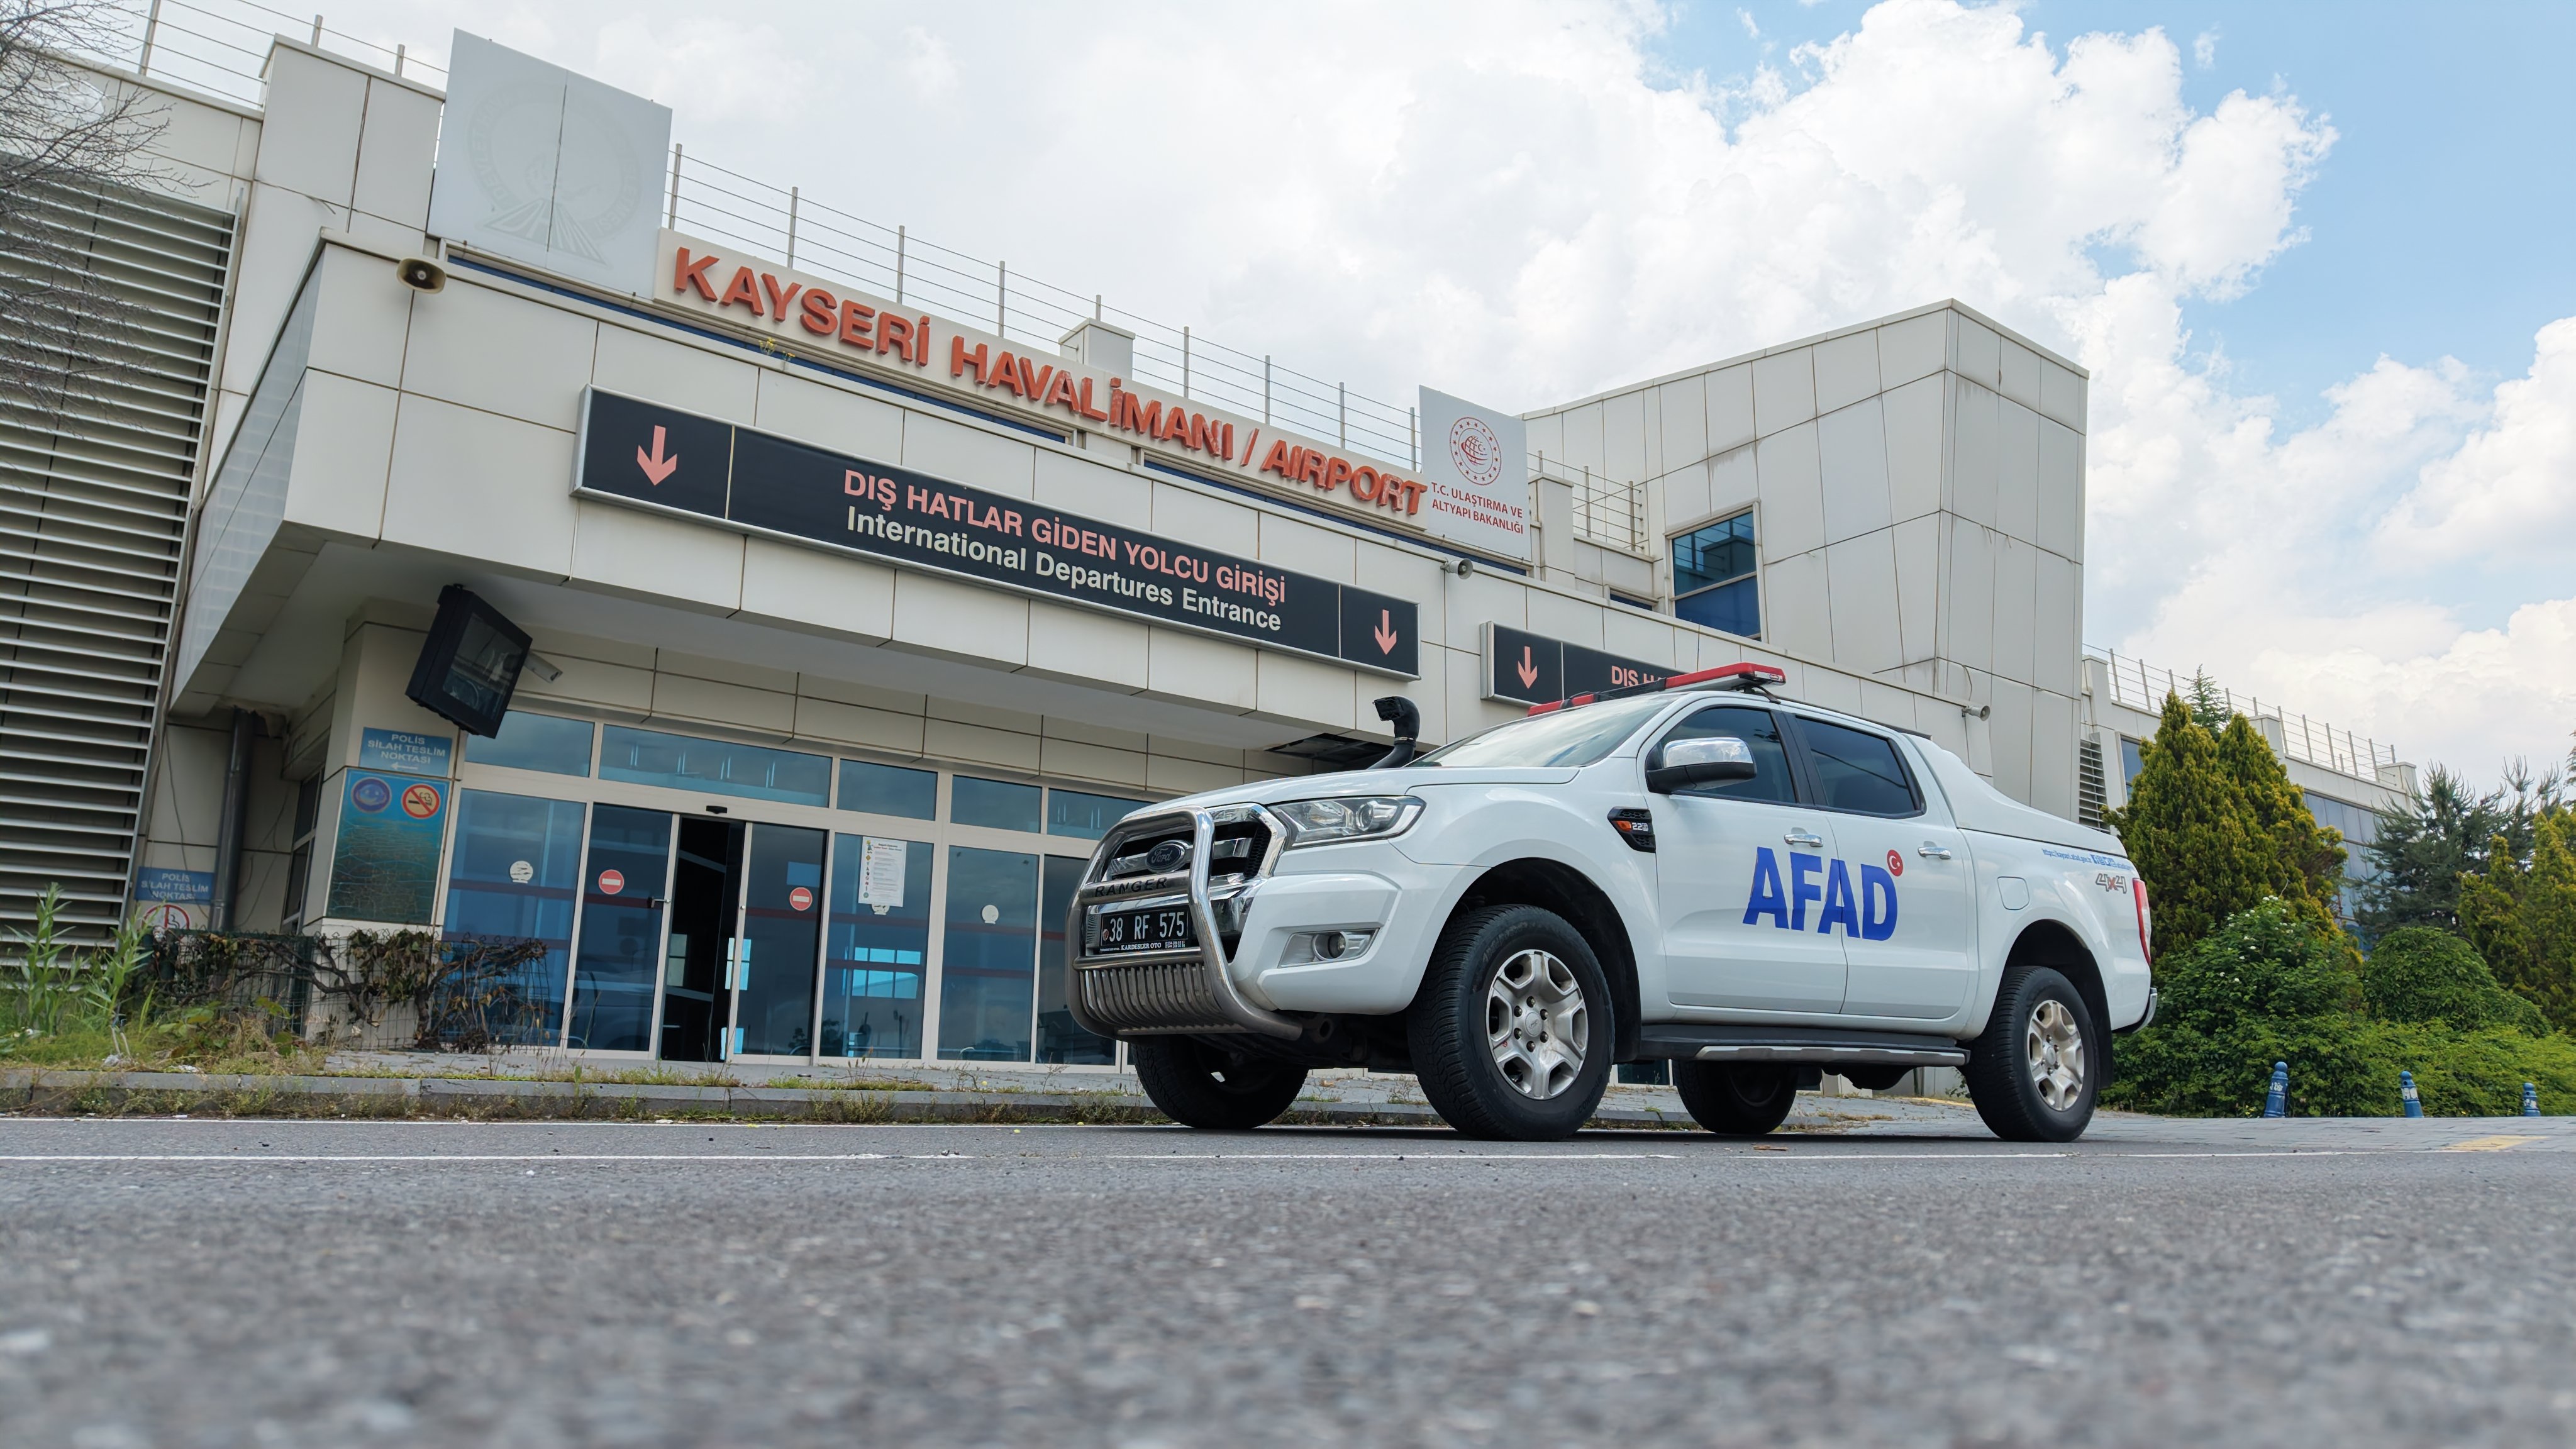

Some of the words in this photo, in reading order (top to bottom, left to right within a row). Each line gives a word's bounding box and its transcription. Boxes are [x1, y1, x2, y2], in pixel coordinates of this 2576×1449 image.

[674, 247, 930, 367] KAYSERİ
[951, 335, 1233, 460] HAVALİMANI
[1260, 440, 1428, 516] AIRPORT
[1431, 482, 1449, 496] T.C.
[1452, 488, 1508, 514] ULAŞTIRMA
[1511, 506, 1523, 518] VE
[1432, 499, 1471, 519] ALTYAPI
[1474, 511, 1523, 534] BAKANLIĞI
[845, 469, 897, 511] DIŞ
[907, 485, 1023, 537] HATLAR
[1031, 516, 1116, 561] GİDEN
[1124, 540, 1209, 583] YOLCU
[1216, 564, 1285, 607] GİRİŞİ
[848, 506, 1026, 571] International
[1036, 552, 1173, 606] Departures
[1182, 587, 1281, 631] Entrance
[368, 740, 401, 752] SİLAH
[406, 745, 445, 757] TESLİM
[391, 734, 425, 745] POLİS
[381, 751, 431, 764] NOKTASI
[1152, 848, 1173, 863] Ford
[1095, 877, 1167, 897] RANGER
[1742, 847, 1897, 941] AFAD
[1109, 917, 1123, 941] 38
[1135, 914, 1150, 940] RF
[1159, 912, 1184, 938] 575
